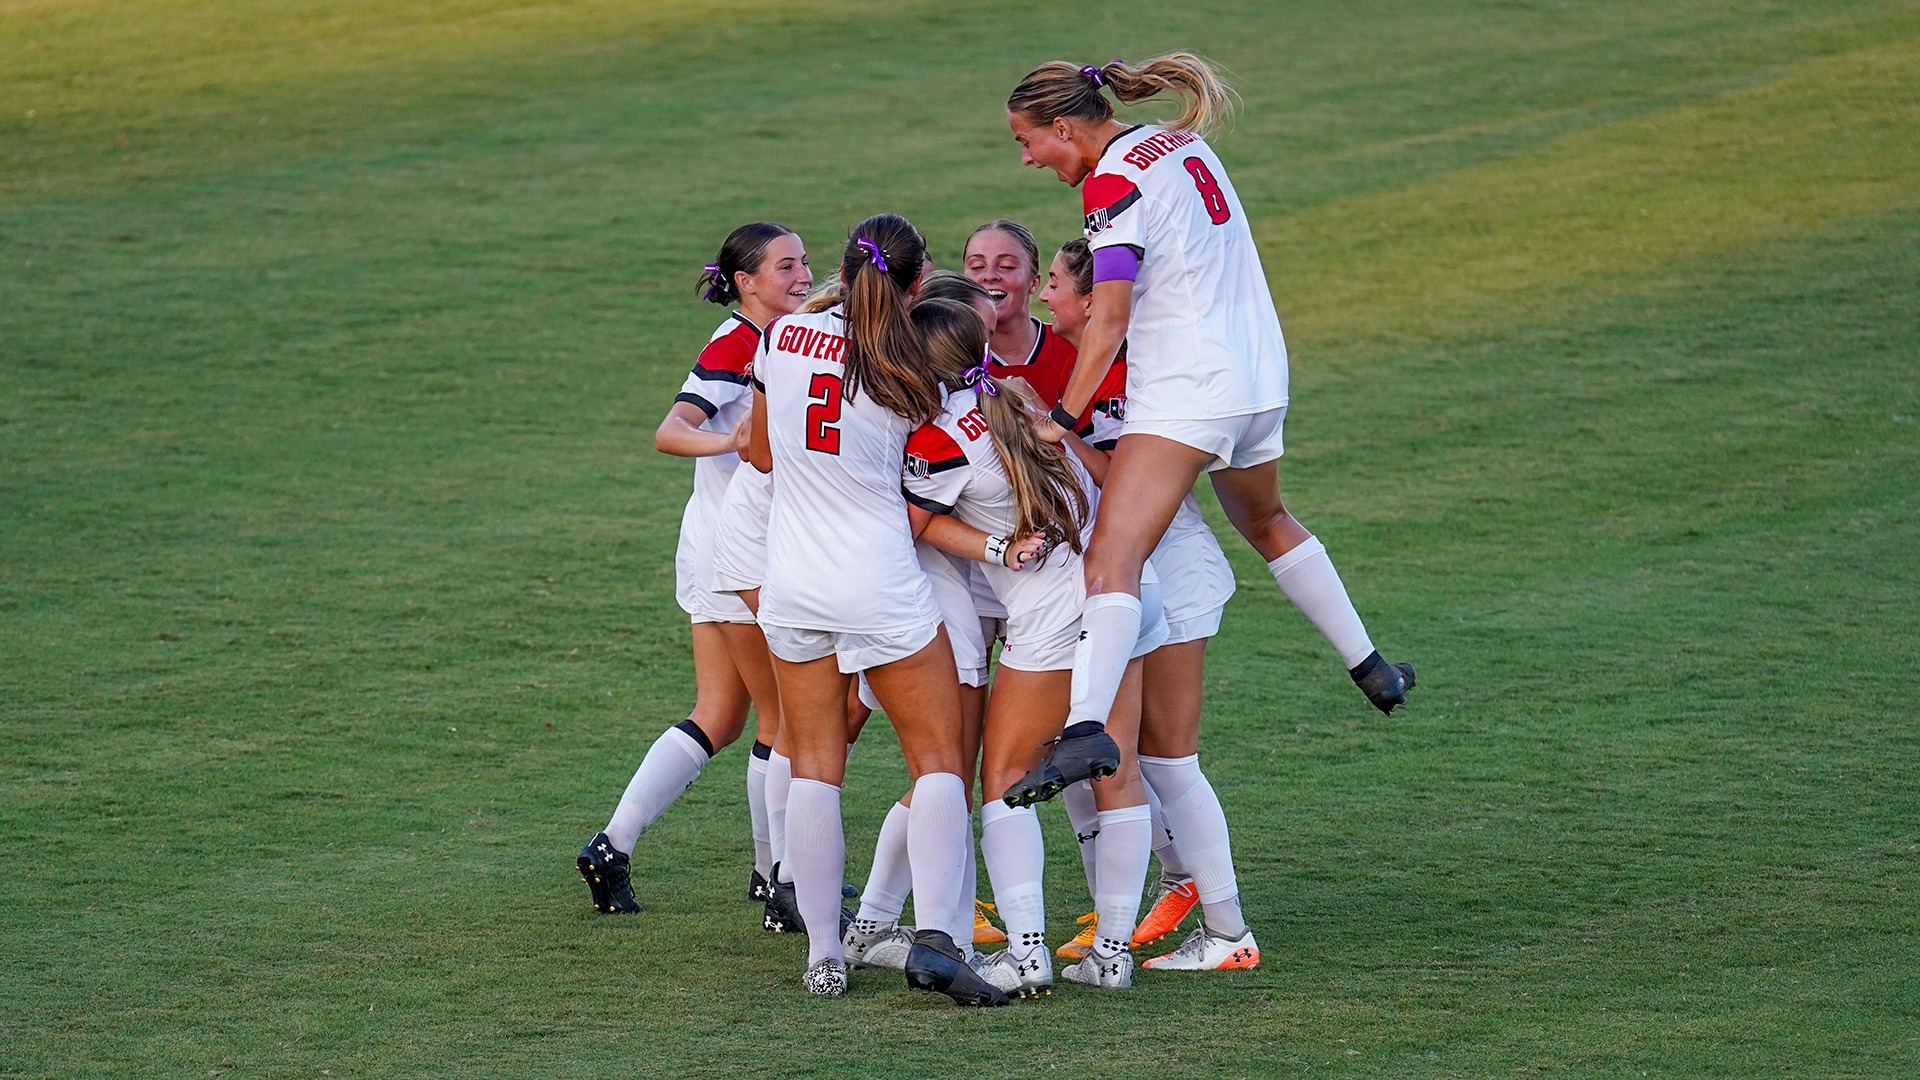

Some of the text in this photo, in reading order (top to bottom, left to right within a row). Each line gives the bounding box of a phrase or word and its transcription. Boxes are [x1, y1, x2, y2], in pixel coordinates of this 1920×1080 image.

[1122, 130, 1198, 171] GOVERNO
[1183, 156, 1231, 225] 8
[805, 371, 842, 456] 2
[957, 404, 989, 442] GO
